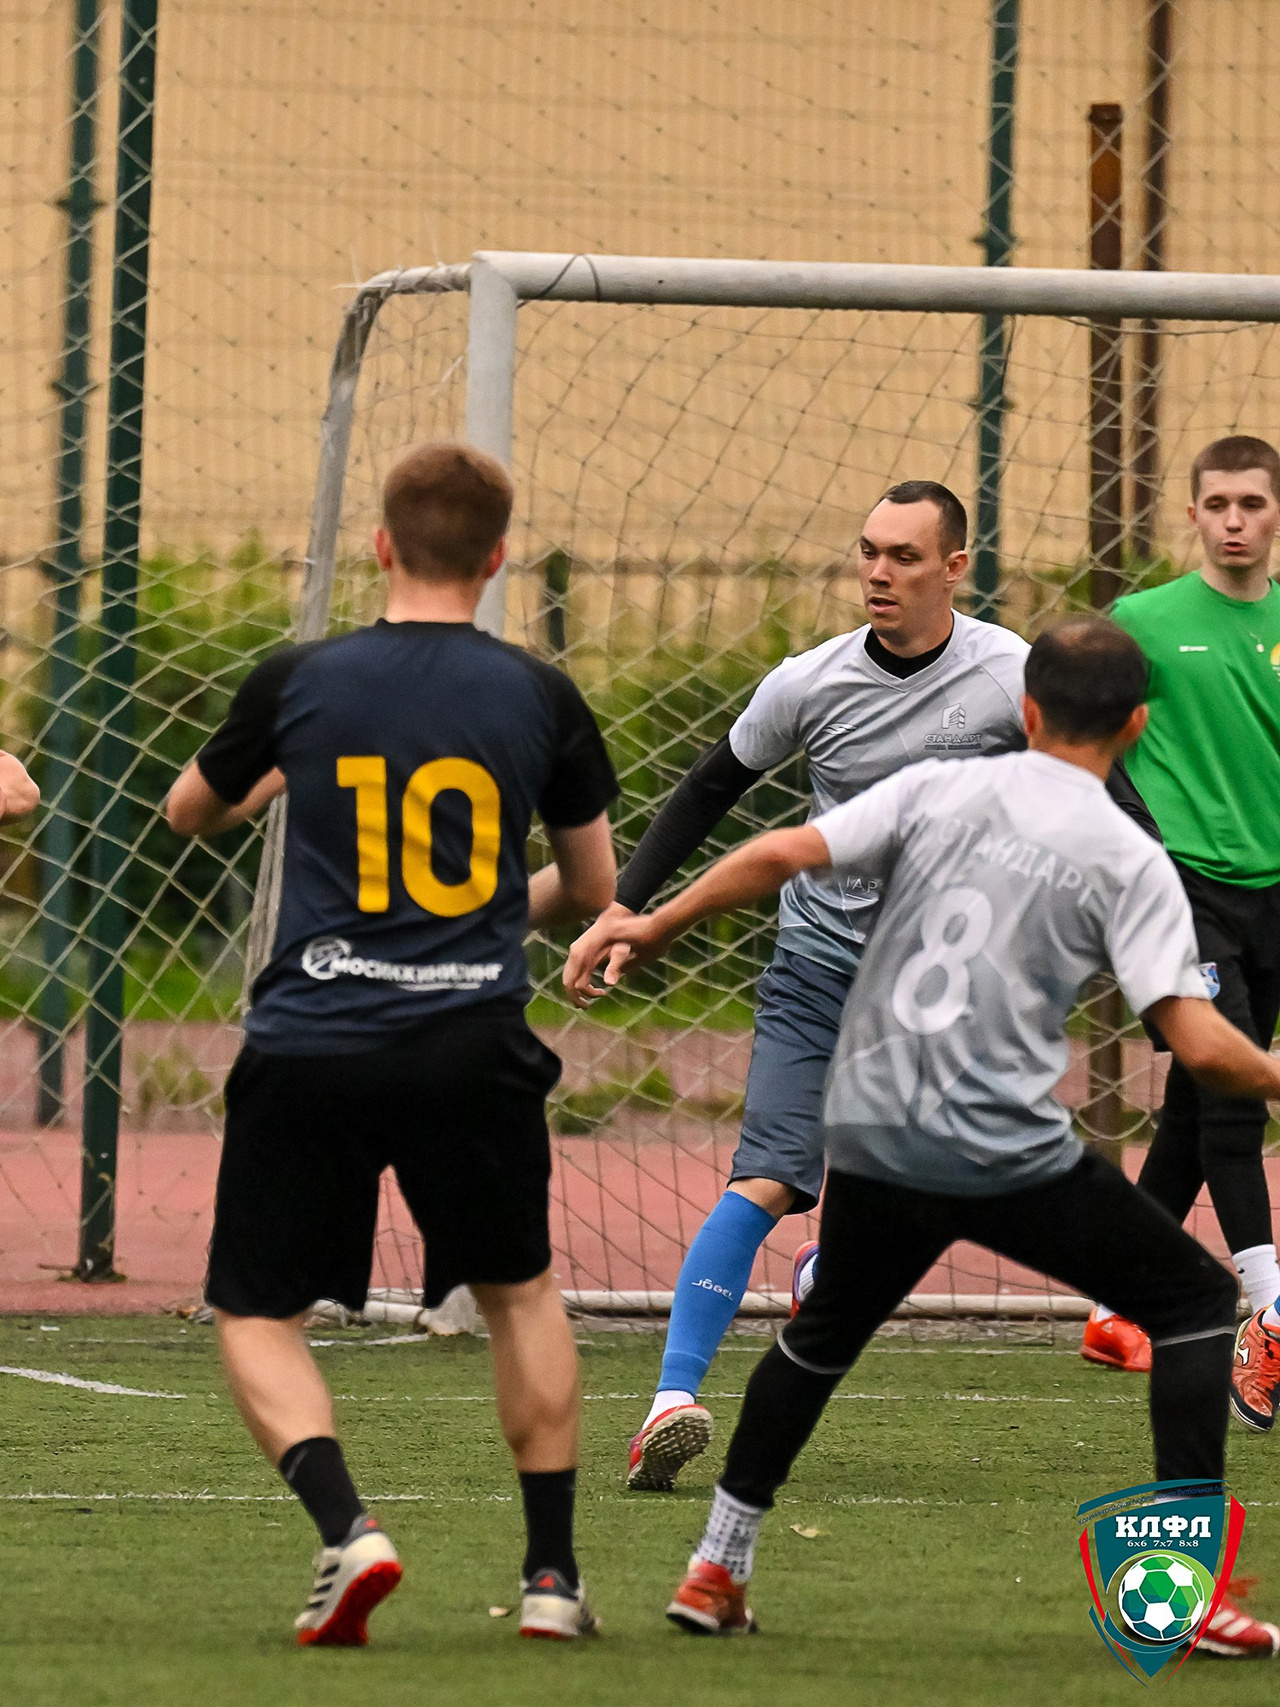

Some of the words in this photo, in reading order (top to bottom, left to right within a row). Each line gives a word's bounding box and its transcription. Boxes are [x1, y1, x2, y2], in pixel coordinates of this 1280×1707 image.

[924, 733, 982, 744] СТАНДАРТ
[336, 755, 501, 918] 10
[892, 886, 993, 1034] 8
[691, 1278, 734, 1301] JÖGEL
